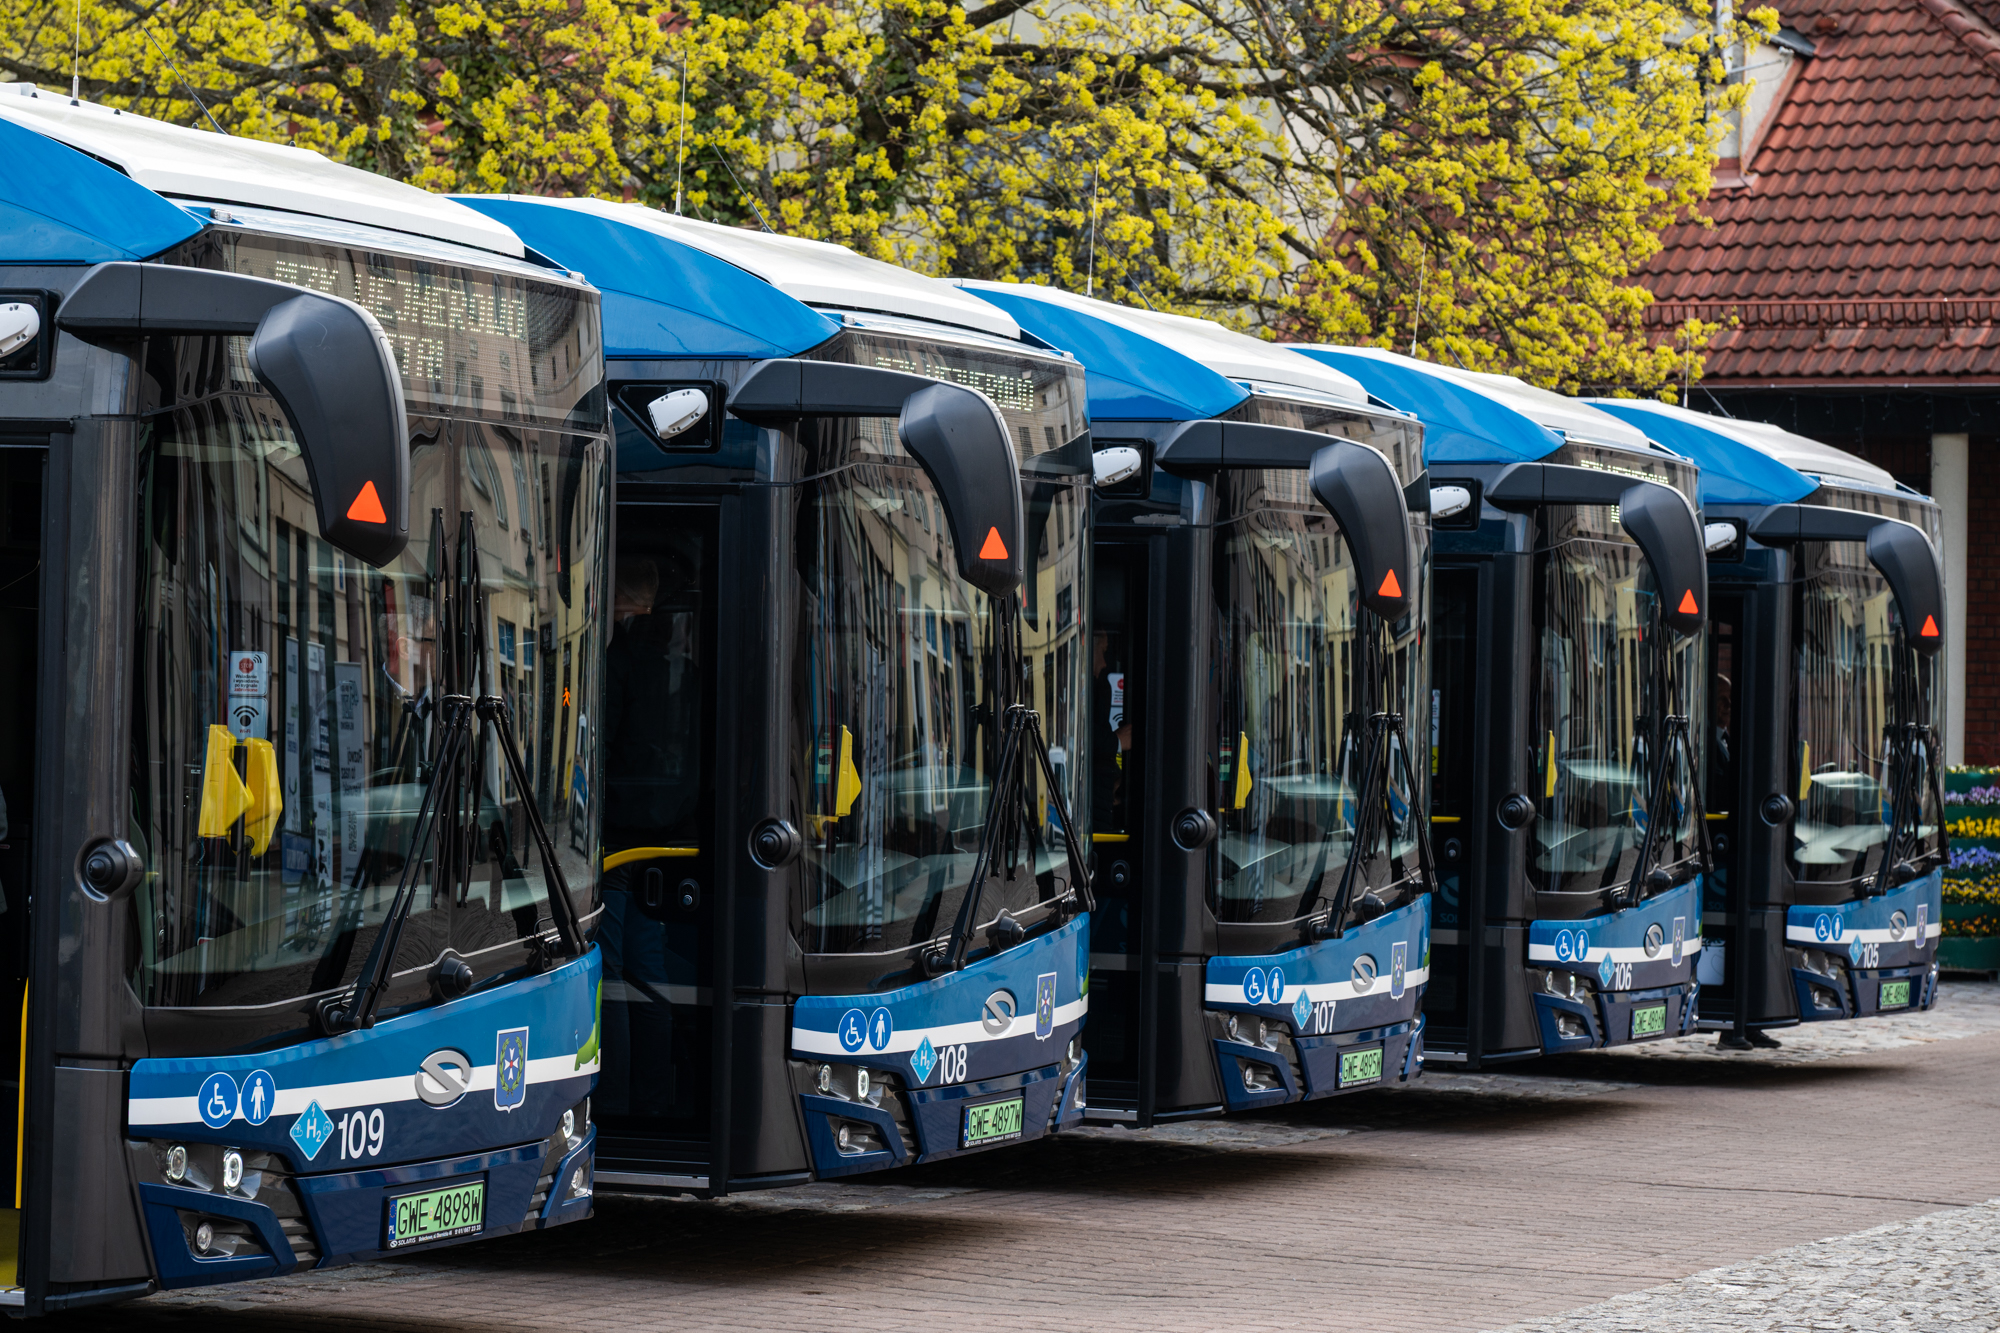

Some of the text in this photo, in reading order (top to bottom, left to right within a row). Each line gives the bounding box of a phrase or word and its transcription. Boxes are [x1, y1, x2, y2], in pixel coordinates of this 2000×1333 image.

[1863, 943, 1880, 969] 105
[1615, 963, 1633, 991] 106
[1314, 1000, 1337, 1035] 107
[939, 1043, 968, 1085] 108
[1343, 1051, 1382, 1080] GWE 4895W
[337, 1107, 385, 1160] 109
[970, 1103, 1022, 1138] GWE 4897W
[398, 1188, 482, 1236] GWE 4898W
[388, 1224, 396, 1235] PL
[397, 1236, 416, 1247] SOLARIS
